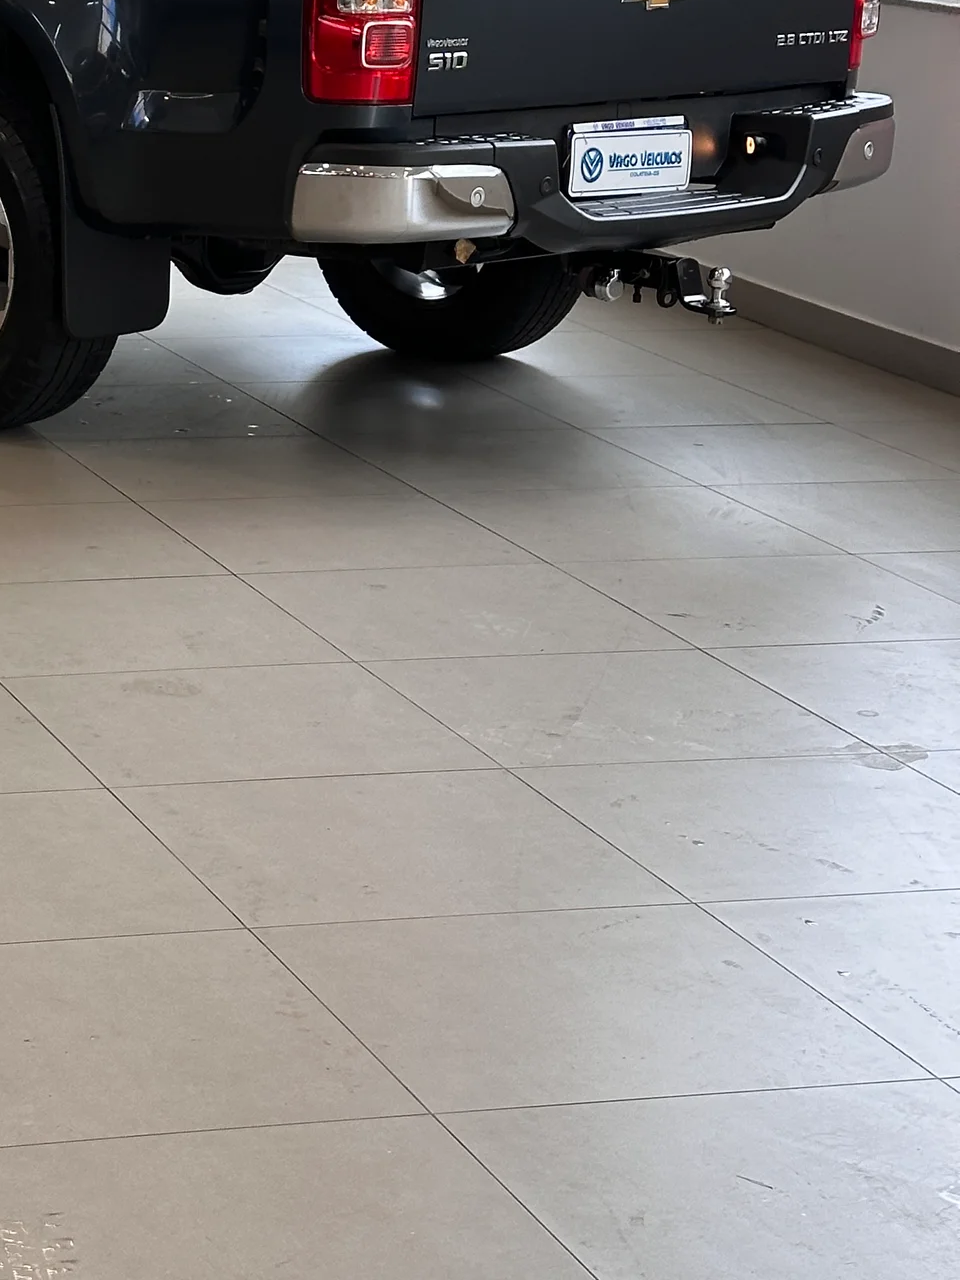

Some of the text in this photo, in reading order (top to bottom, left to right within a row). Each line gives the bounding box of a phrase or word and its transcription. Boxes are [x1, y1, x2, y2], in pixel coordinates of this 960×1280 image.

[829, 30, 848, 43] LTZ
[427, 51, 468, 71] S10
[609, 150, 683, 169] VAGO VEICULOS
